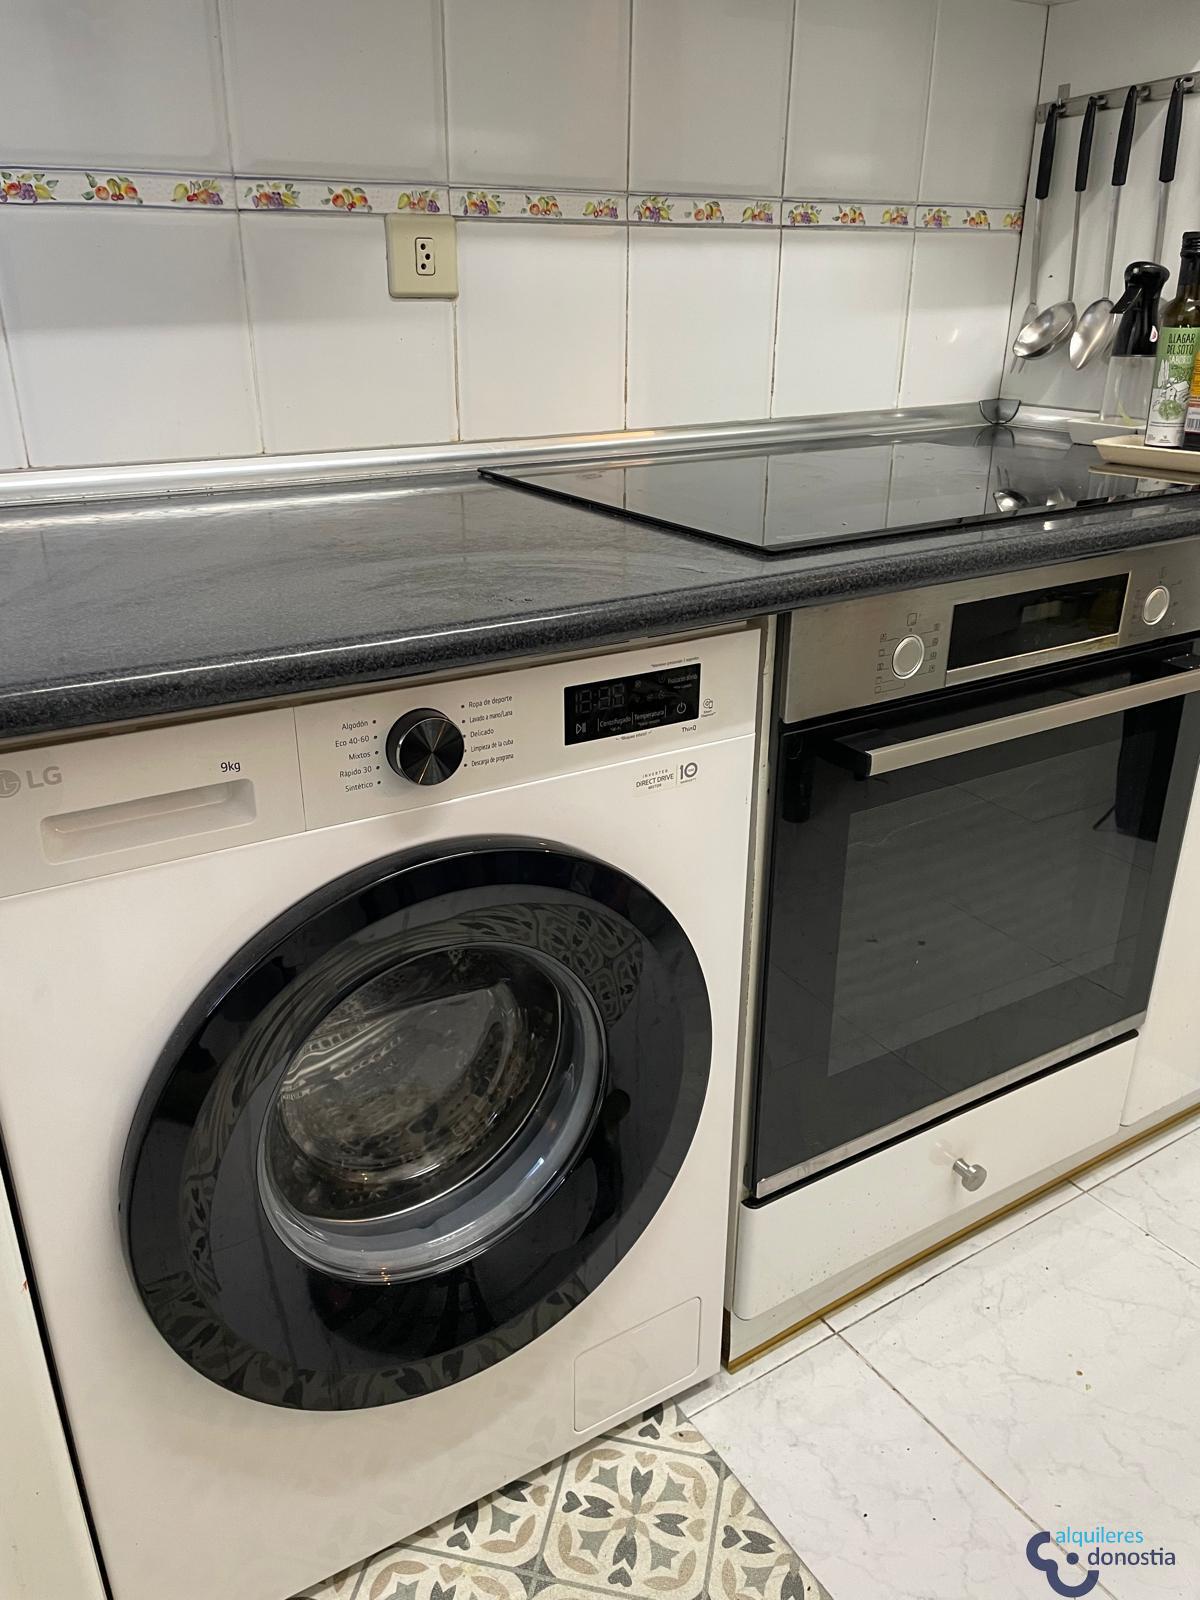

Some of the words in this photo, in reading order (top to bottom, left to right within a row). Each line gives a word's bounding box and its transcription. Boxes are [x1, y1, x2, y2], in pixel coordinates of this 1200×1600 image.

[1176, 344, 1194, 355] SOTO
[492, 696, 513, 704] deporte
[470, 715, 485, 723] Lavado
[342, 720, 369, 730] Algodón
[471, 728, 495, 738] Delicado
[335, 740, 347, 748] Eco
[349, 735, 370, 745] 40-60
[471, 744, 491, 752] Limpieza
[349, 752, 371, 760] Mixtos
[472, 759, 490, 767] Descarga
[496, 754, 514, 763] programa
[220, 761, 241, 773] 9kg
[363, 766, 372, 774] 30
[680, 762, 698, 780] 10
[26, 766, 63, 788] LG
[635, 777, 657, 788] DIRECT
[657, 773, 674, 783] DRIVE
[345, 782, 374, 792] Sintético
